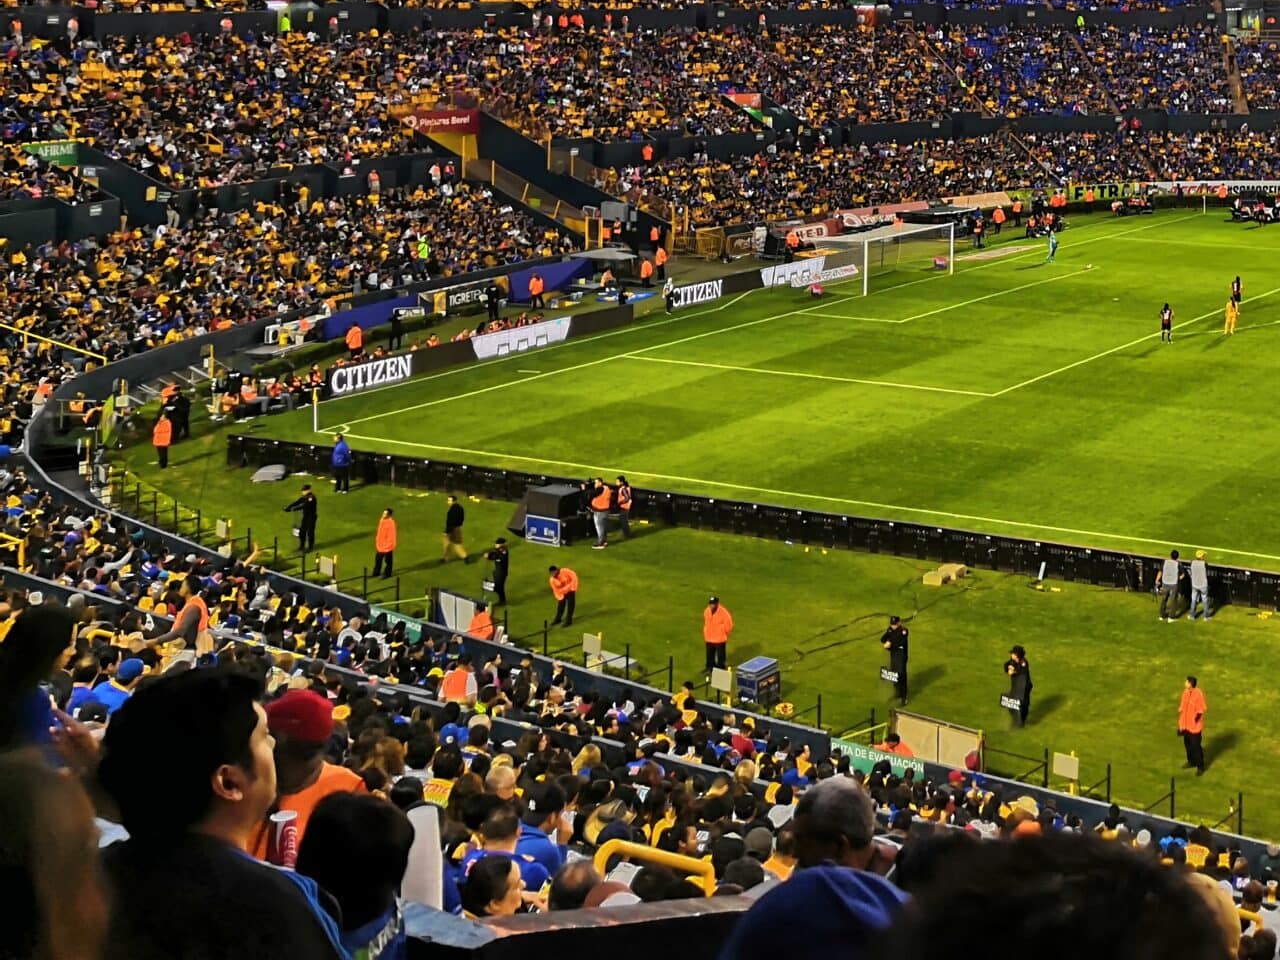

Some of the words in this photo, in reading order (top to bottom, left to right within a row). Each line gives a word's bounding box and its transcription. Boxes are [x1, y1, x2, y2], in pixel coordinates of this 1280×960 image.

[672, 279, 723, 307] CITIZEN
[331, 354, 413, 393] CITIZEN
[855, 748, 867, 759] DE
